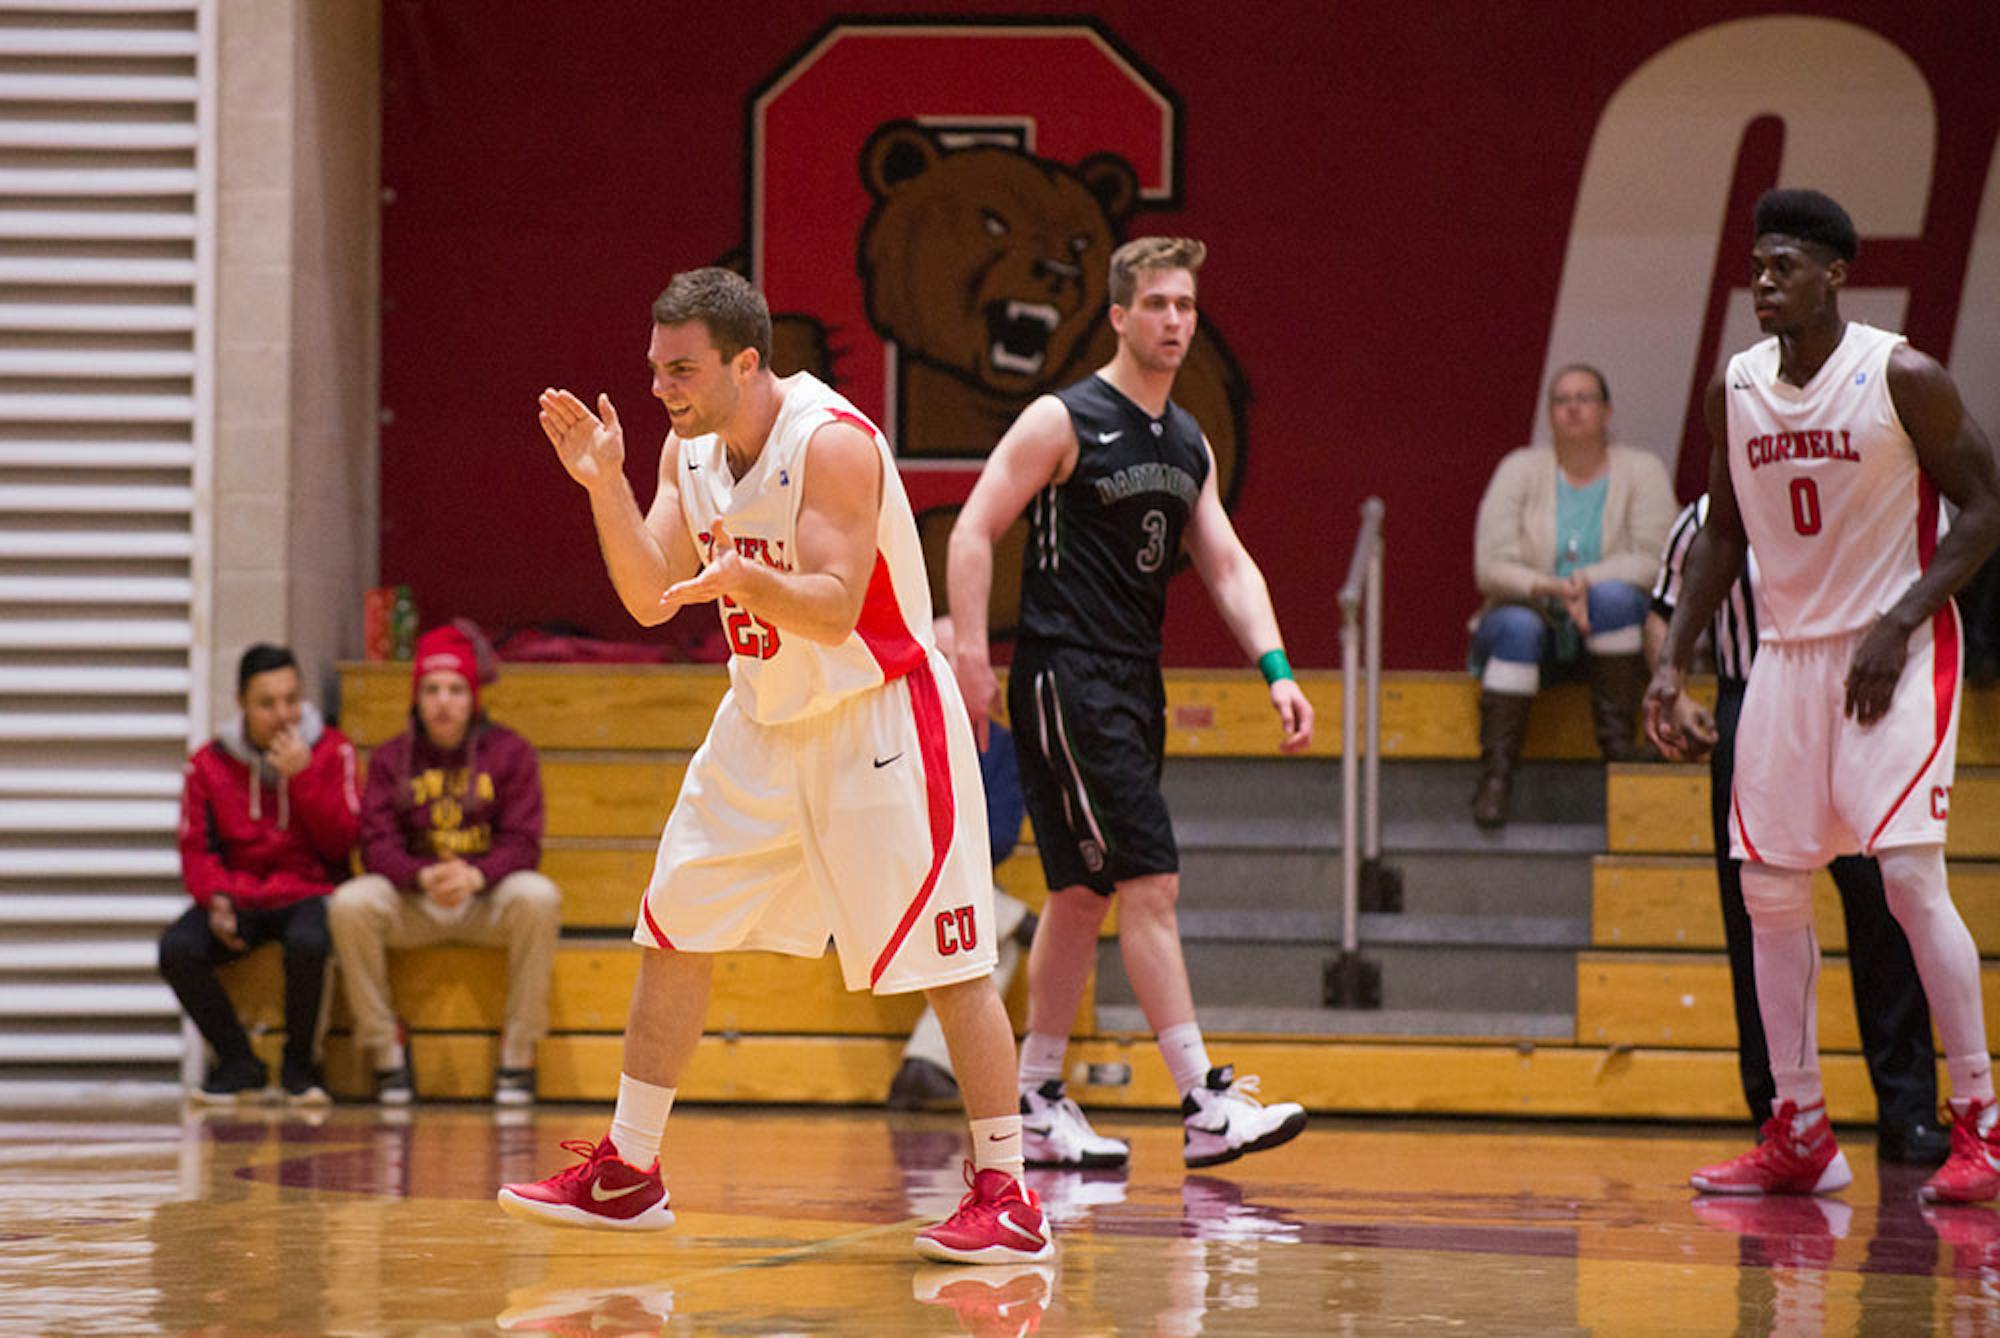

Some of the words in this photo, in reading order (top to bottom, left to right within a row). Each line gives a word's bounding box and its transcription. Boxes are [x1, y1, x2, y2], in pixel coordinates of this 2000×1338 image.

[1746, 430, 1860, 470] CORNELL
[1789, 476, 1822, 536] 0
[1136, 509, 1168, 573] 3
[1930, 785, 1953, 821] C
[935, 905, 977, 957] CU
